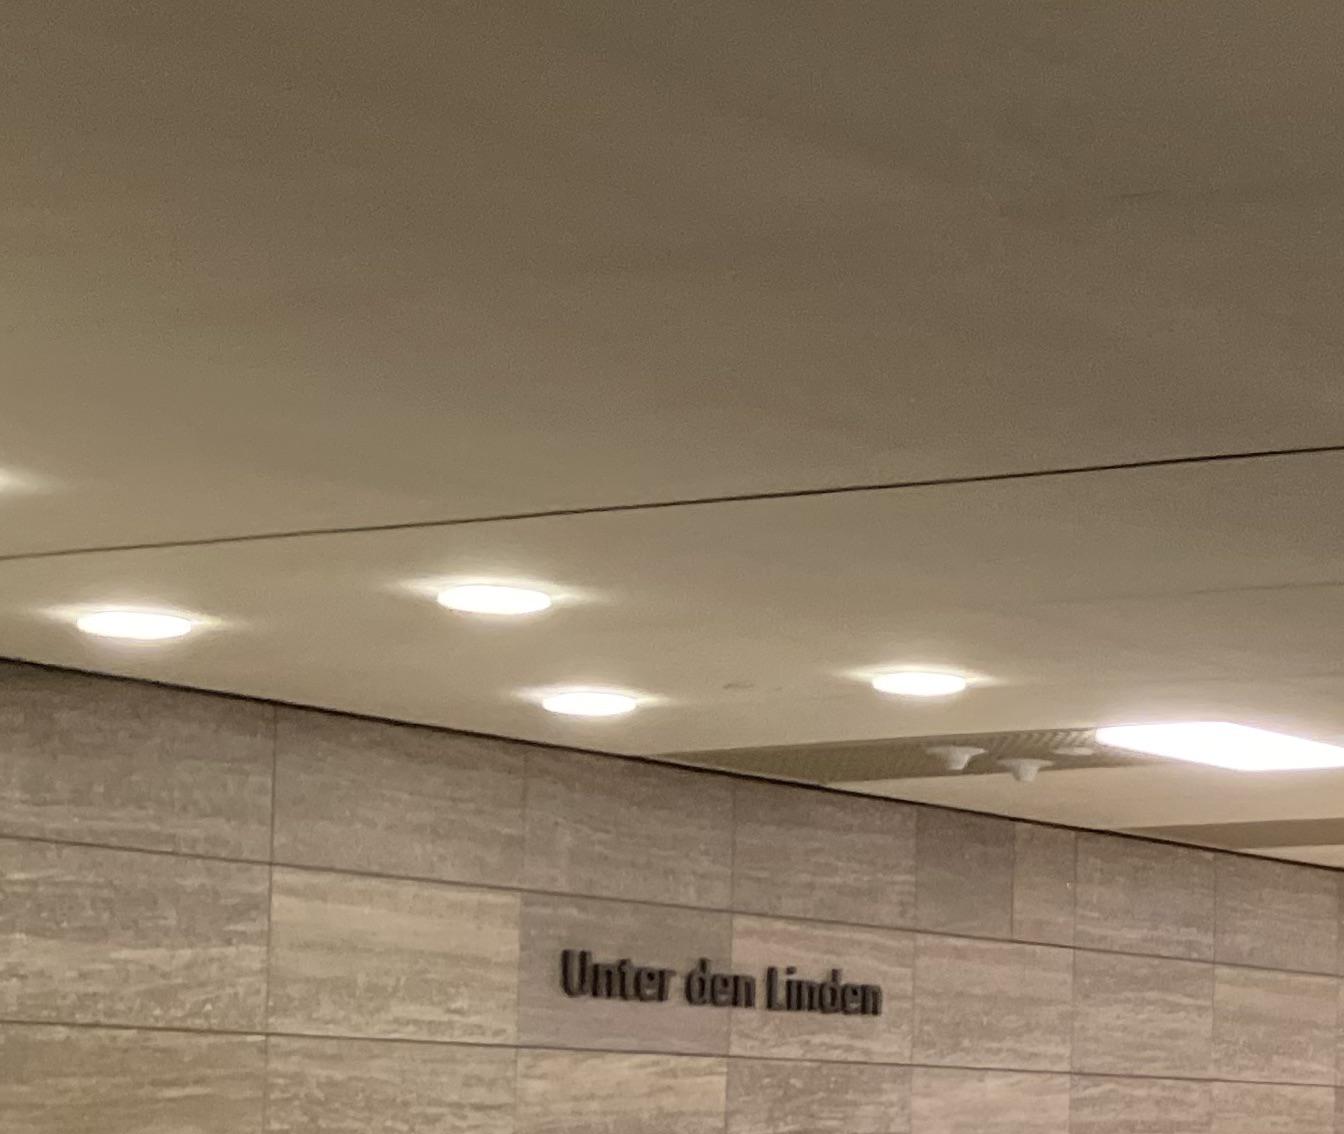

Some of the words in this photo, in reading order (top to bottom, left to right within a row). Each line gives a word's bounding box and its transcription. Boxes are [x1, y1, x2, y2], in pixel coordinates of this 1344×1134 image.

[560, 949, 677, 1002] Unter
[685, 957, 756, 1008] den
[765, 965, 883, 1016] Linden
